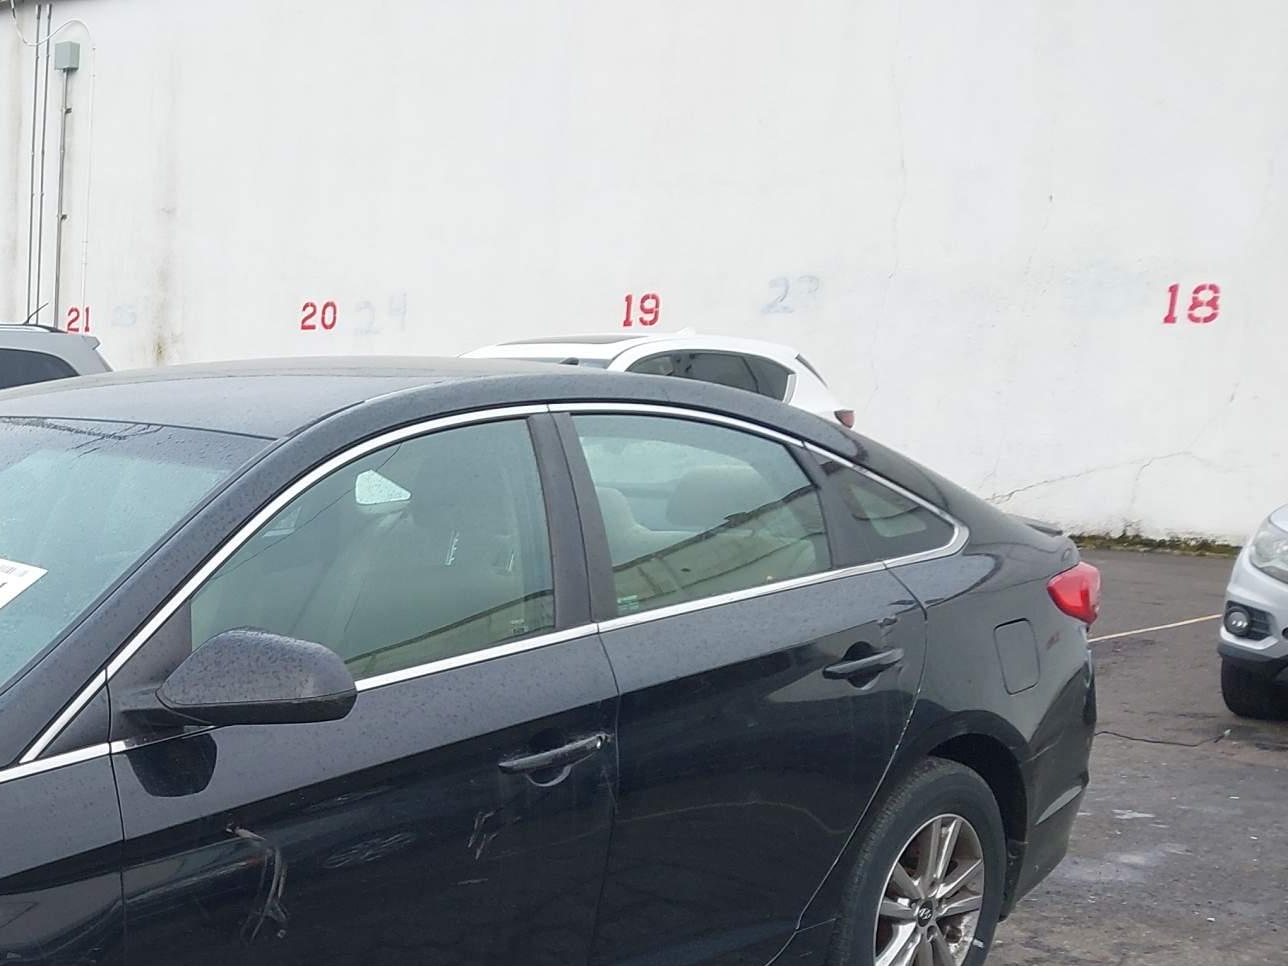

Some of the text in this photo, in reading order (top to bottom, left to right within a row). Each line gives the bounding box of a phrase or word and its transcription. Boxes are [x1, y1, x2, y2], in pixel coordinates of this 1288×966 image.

[67, 306, 90, 333] 21
[300, 301, 337, 331] 20
[622, 292, 661, 328] 19
[1163, 283, 1220, 324] 18
